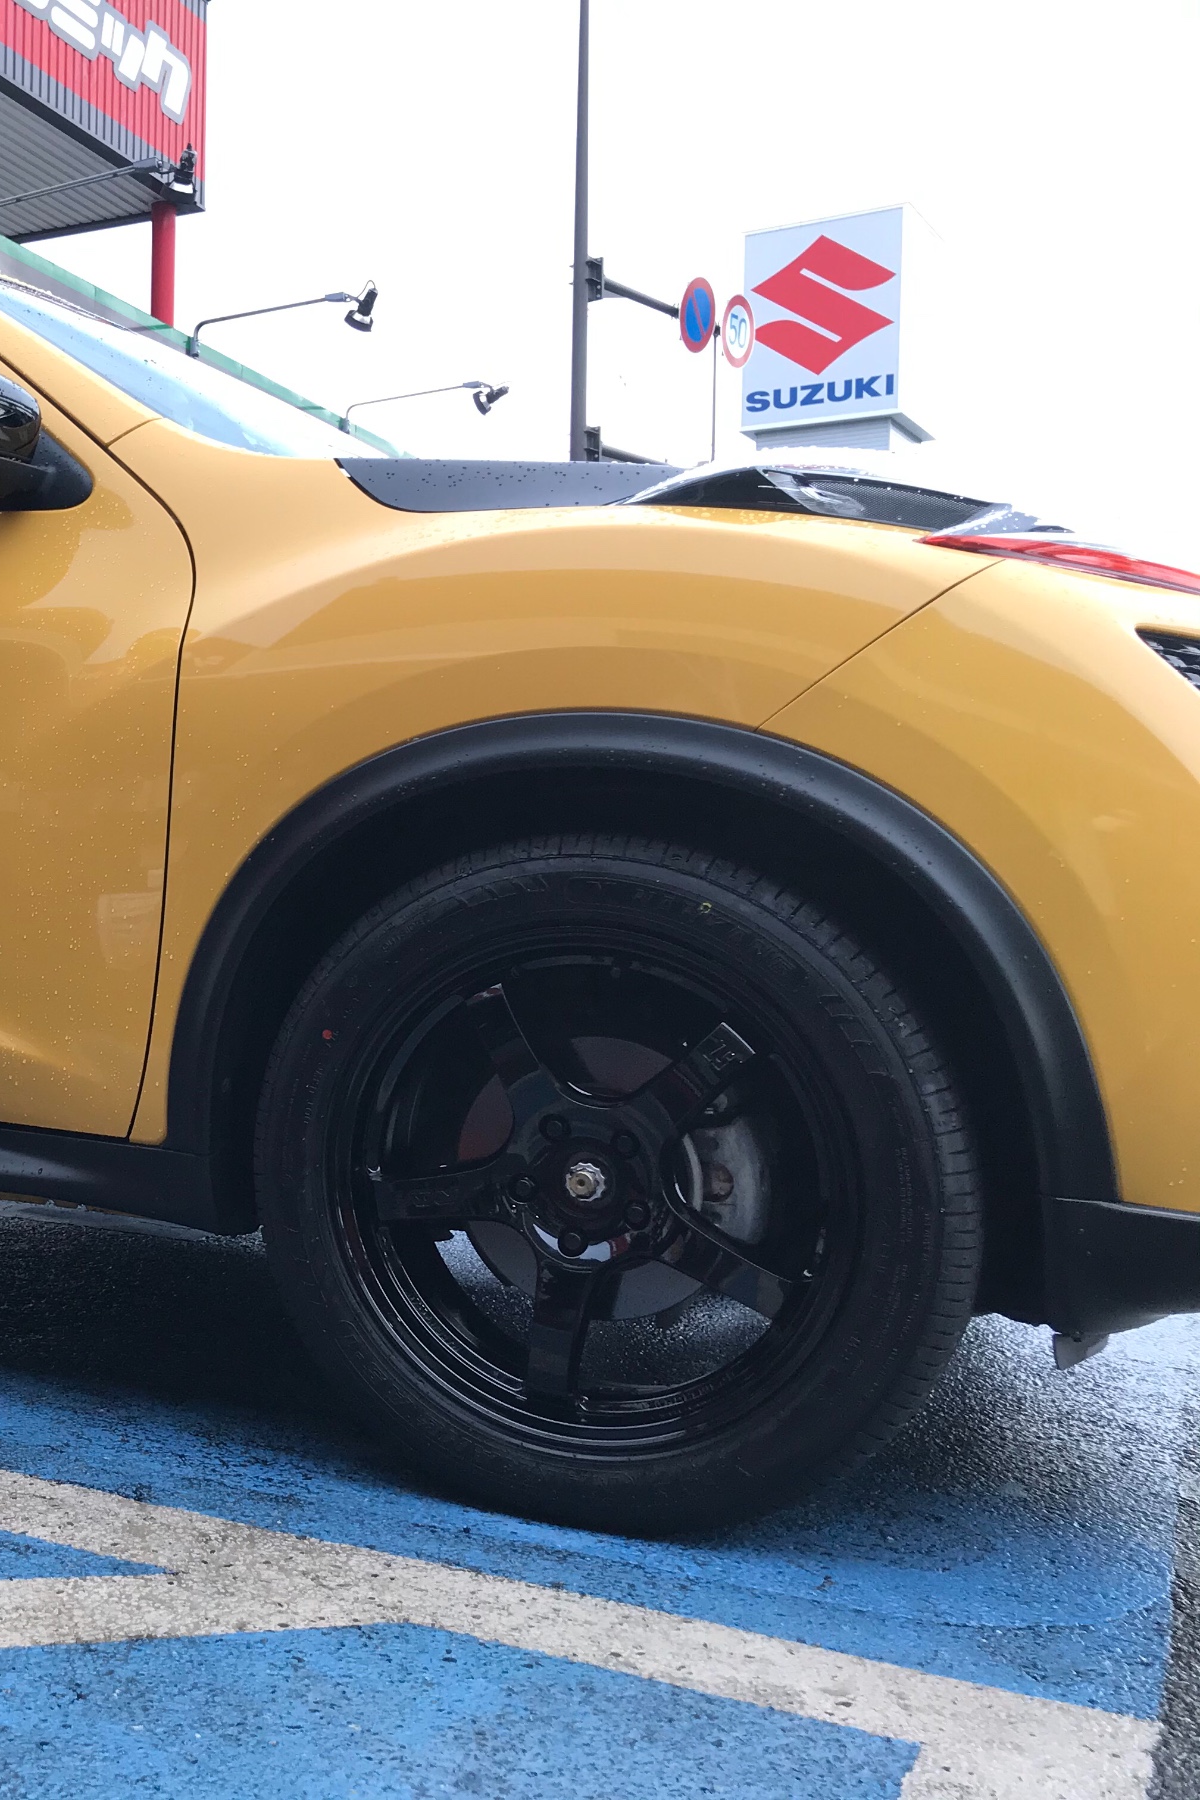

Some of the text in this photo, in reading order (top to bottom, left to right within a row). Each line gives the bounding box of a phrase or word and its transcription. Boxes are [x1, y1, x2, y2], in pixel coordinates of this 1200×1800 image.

[24, 0, 190, 115] ミック
[728, 312, 748, 349] 50
[745, 373, 894, 413] SUZUKI
